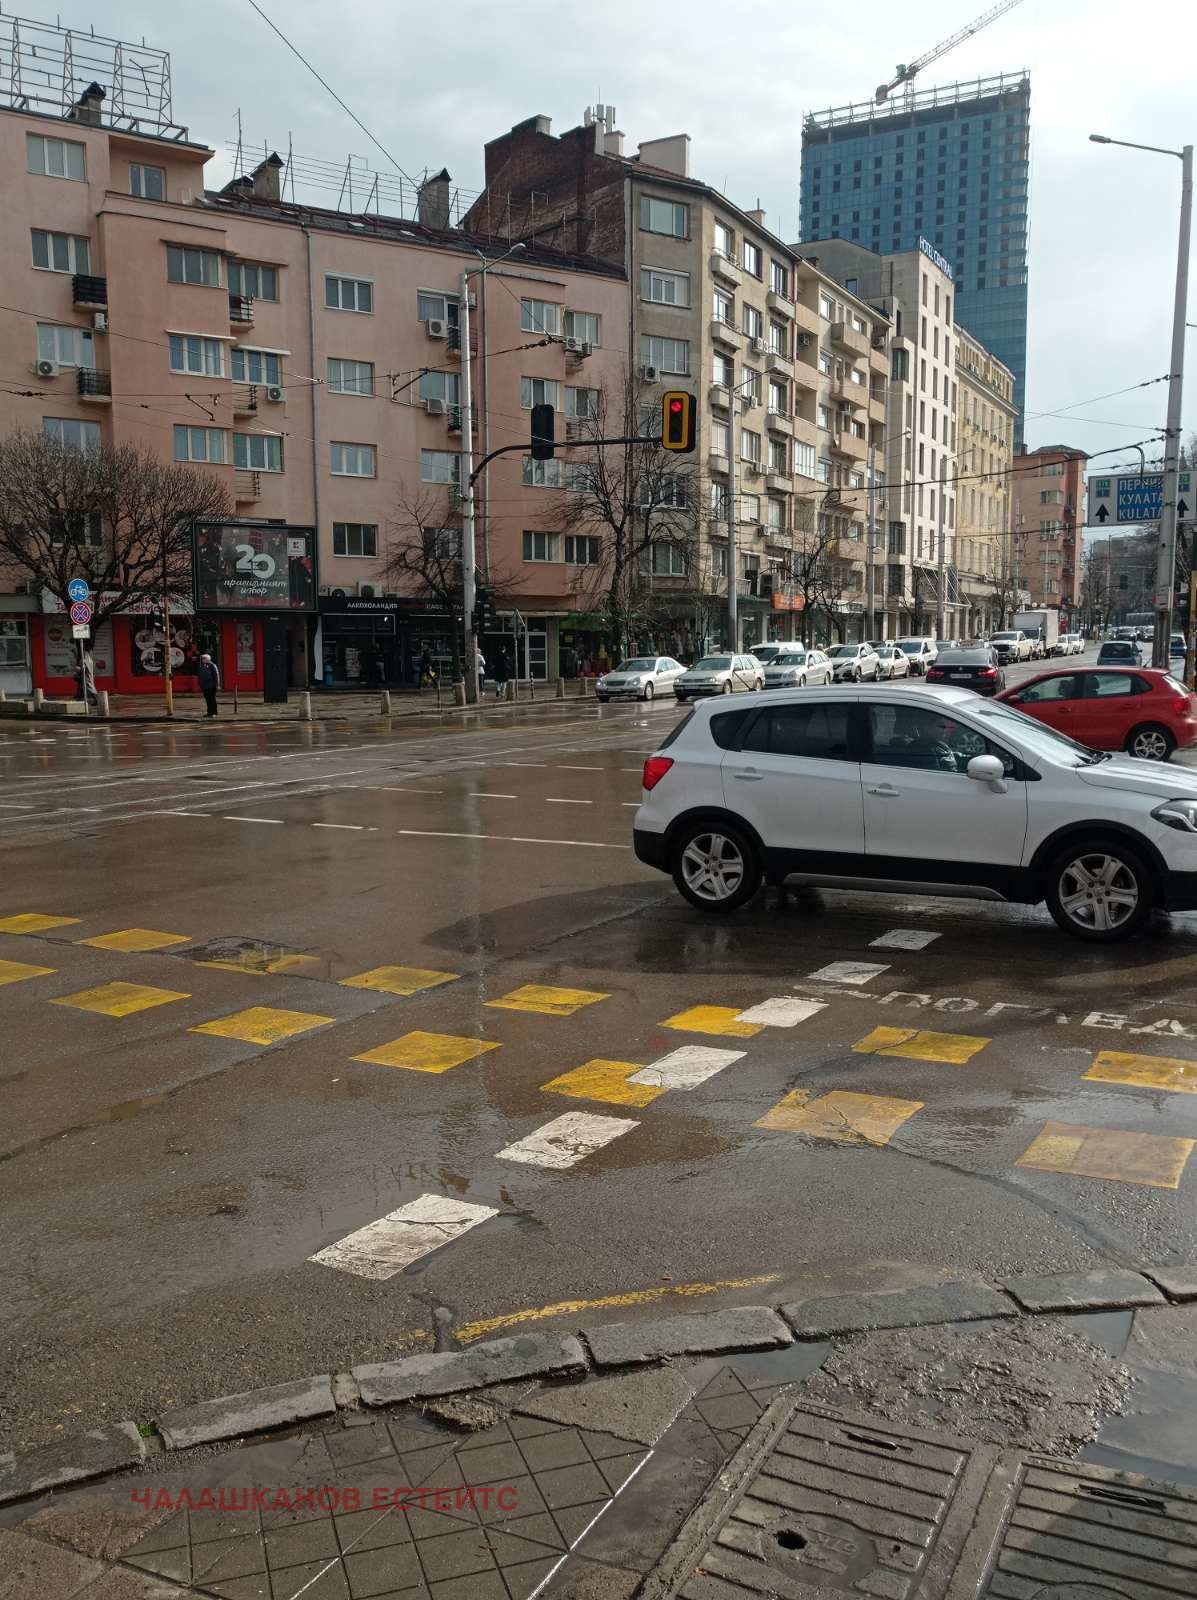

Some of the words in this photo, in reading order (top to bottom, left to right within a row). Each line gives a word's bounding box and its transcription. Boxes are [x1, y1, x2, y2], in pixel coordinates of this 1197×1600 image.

[919, 235, 934, 260] HOTEL
[933, 250, 953, 279] CENTRAL
[235, 544, 276, 579] 20
